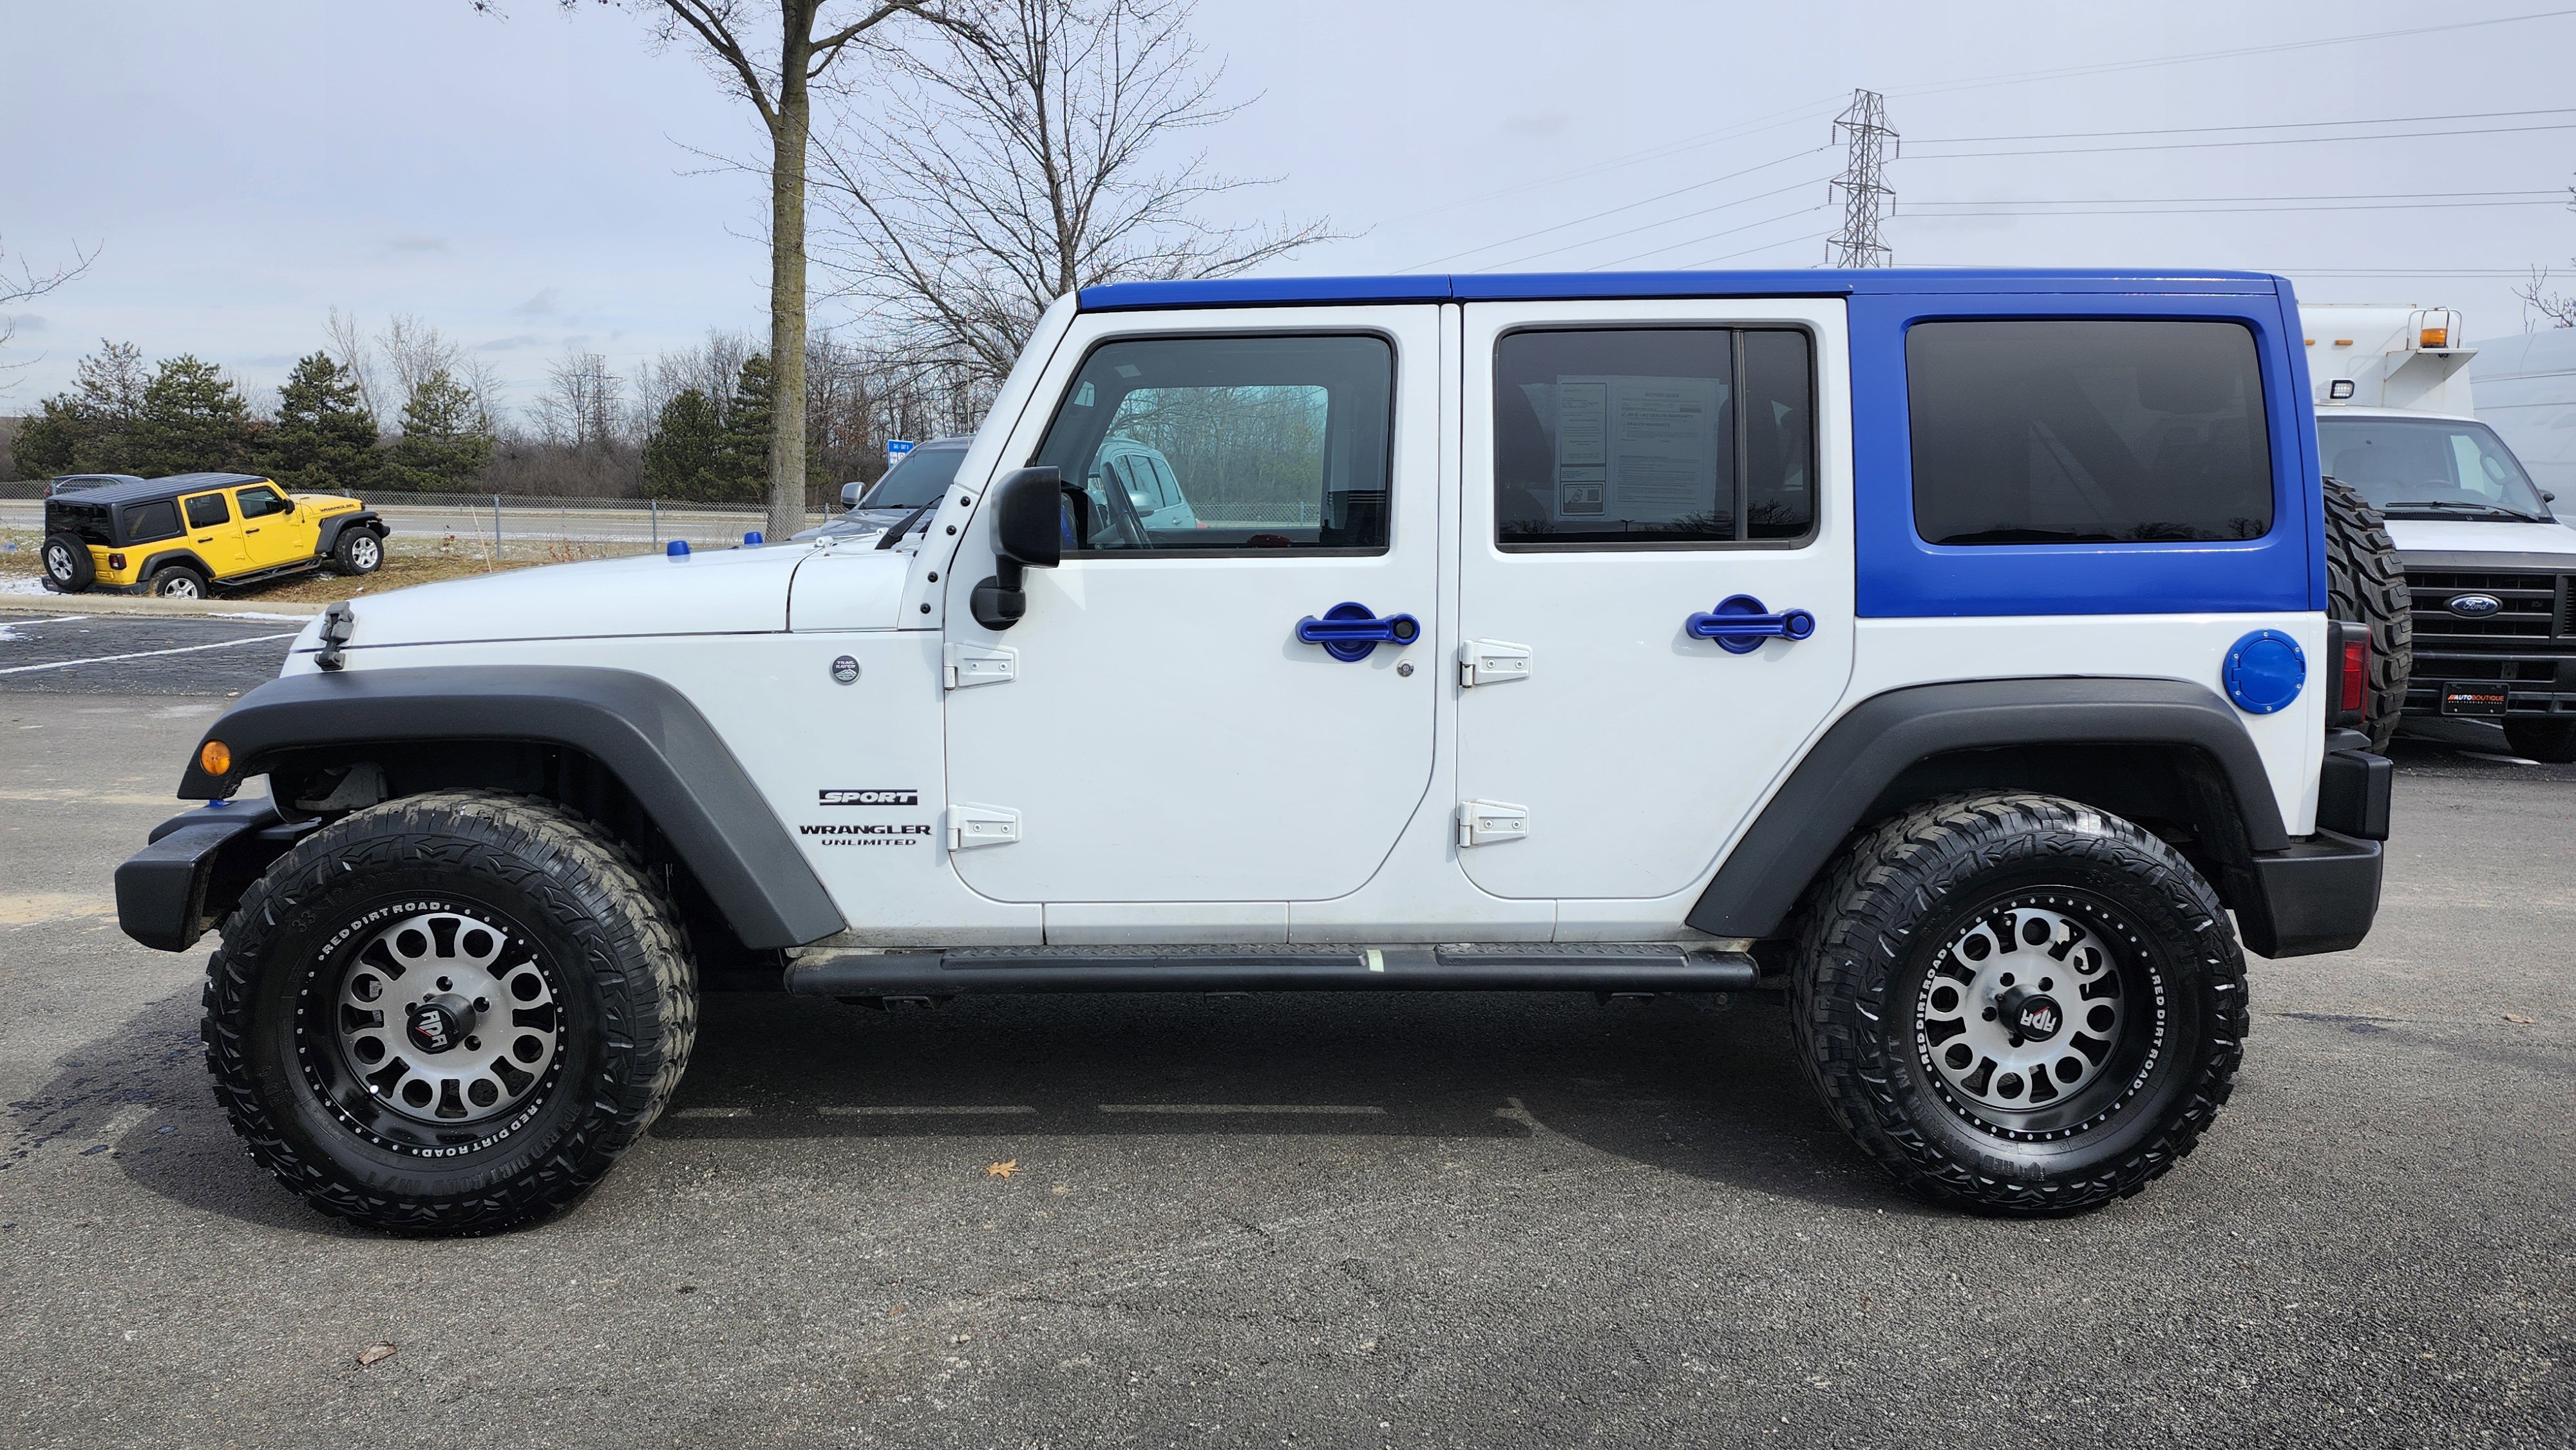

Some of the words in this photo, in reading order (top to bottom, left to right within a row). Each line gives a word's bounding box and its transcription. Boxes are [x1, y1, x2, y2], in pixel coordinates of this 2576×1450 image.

[2463, 599, 2489, 610] Ford
[821, 791, 918, 804] SPORT
[799, 824, 933, 836] WRANGLER
[322, 929, 350, 955] RED
[350, 908, 388, 930] DIRT
[392, 902, 440, 914] ROAD
[1922, 948, 1947, 990] ROAD
[2152, 975, 2164, 1006] RED
[1916, 992, 1927, 1030] DIRT
[2153, 1009, 2165, 1047] DIRT
[1917, 1032, 1930, 1065] RED
[2133, 1048, 2159, 1089] ROAD
[511, 1105, 538, 1131] RED
[422, 1145, 469, 1158] ROAD
[473, 1130, 509, 1151] DIRT
